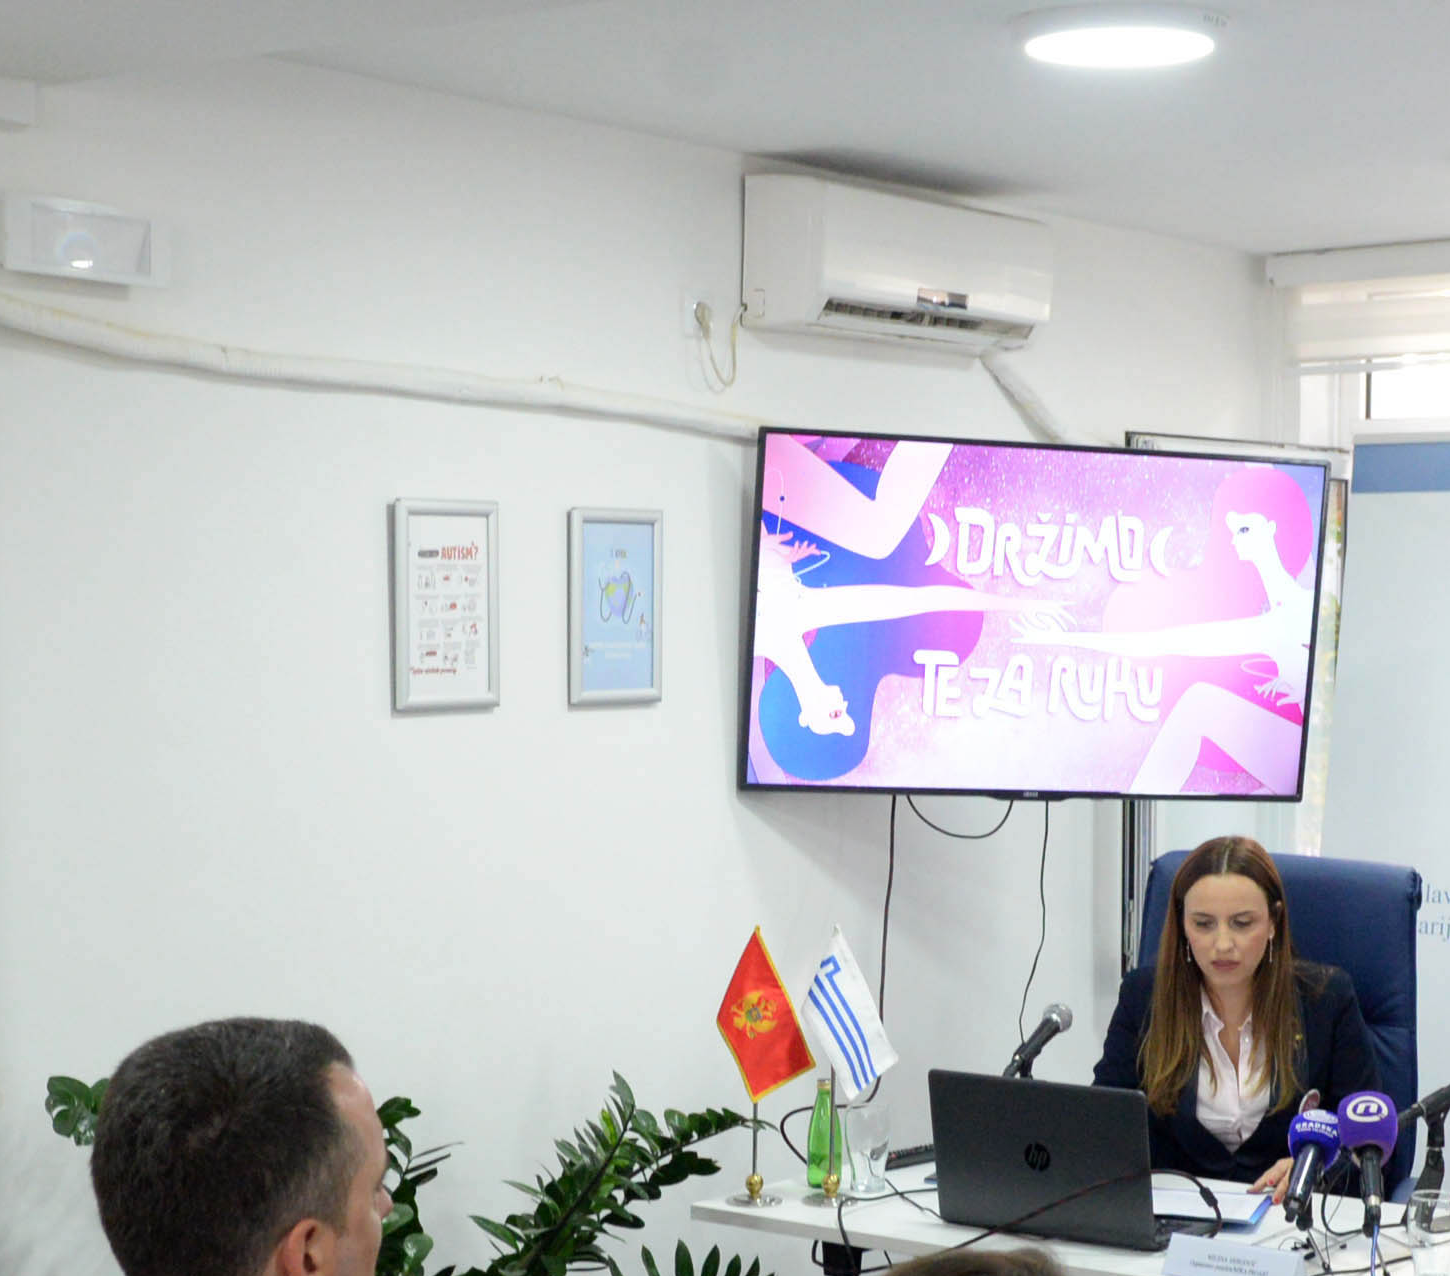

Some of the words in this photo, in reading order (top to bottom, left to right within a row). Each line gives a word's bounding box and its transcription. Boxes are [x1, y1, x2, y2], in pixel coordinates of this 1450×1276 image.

[954, 506, 1145, 587] DRŽIMO
[913, 649, 962, 718] TE
[968, 653, 1035, 718] ZA
